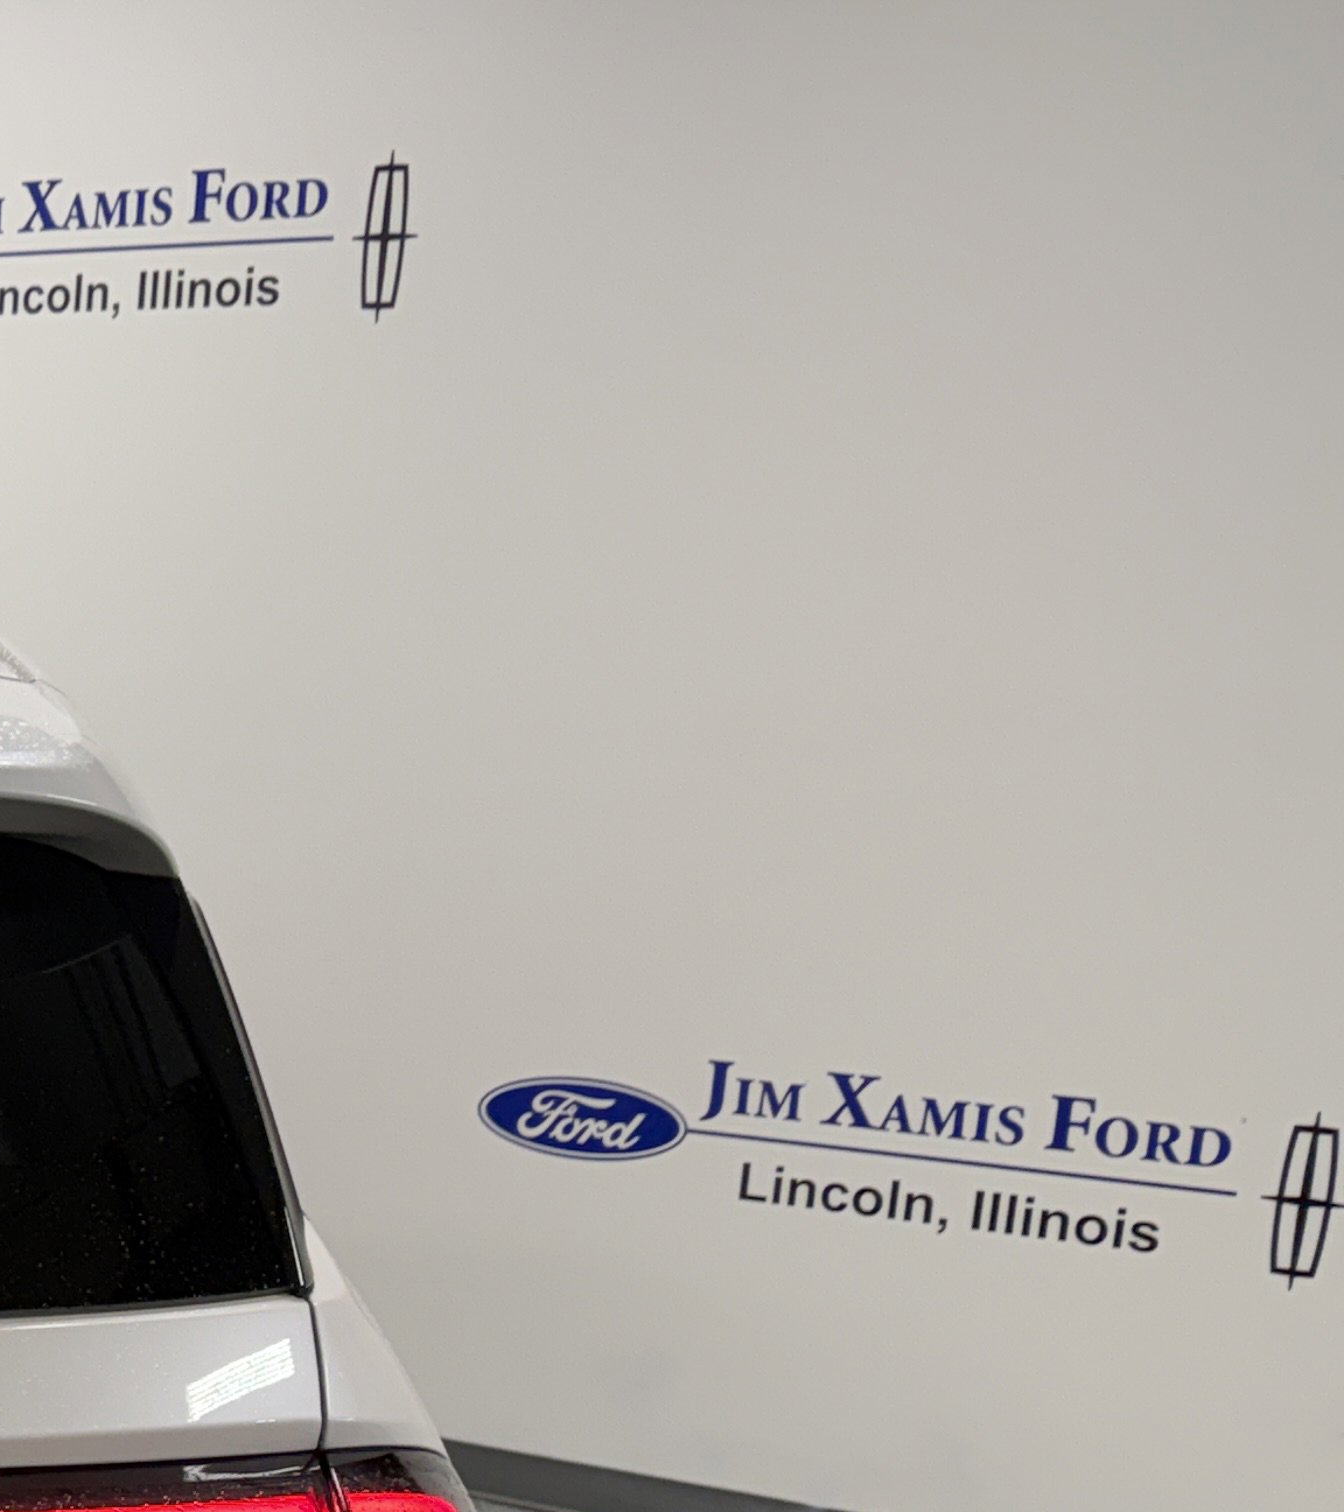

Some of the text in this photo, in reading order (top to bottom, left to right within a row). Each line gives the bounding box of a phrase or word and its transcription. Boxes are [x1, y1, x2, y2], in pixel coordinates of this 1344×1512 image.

[17, 179, 172, 234] XAMIS
[188, 168, 328, 225] FORD
[136, 267, 280, 311] Illinois
[514, 1090, 641, 1154] Ford
[699, 1059, 1232, 1169] JIM XAMIS FORD
[737, 1161, 1161, 1255] Lincoln, Illinois
